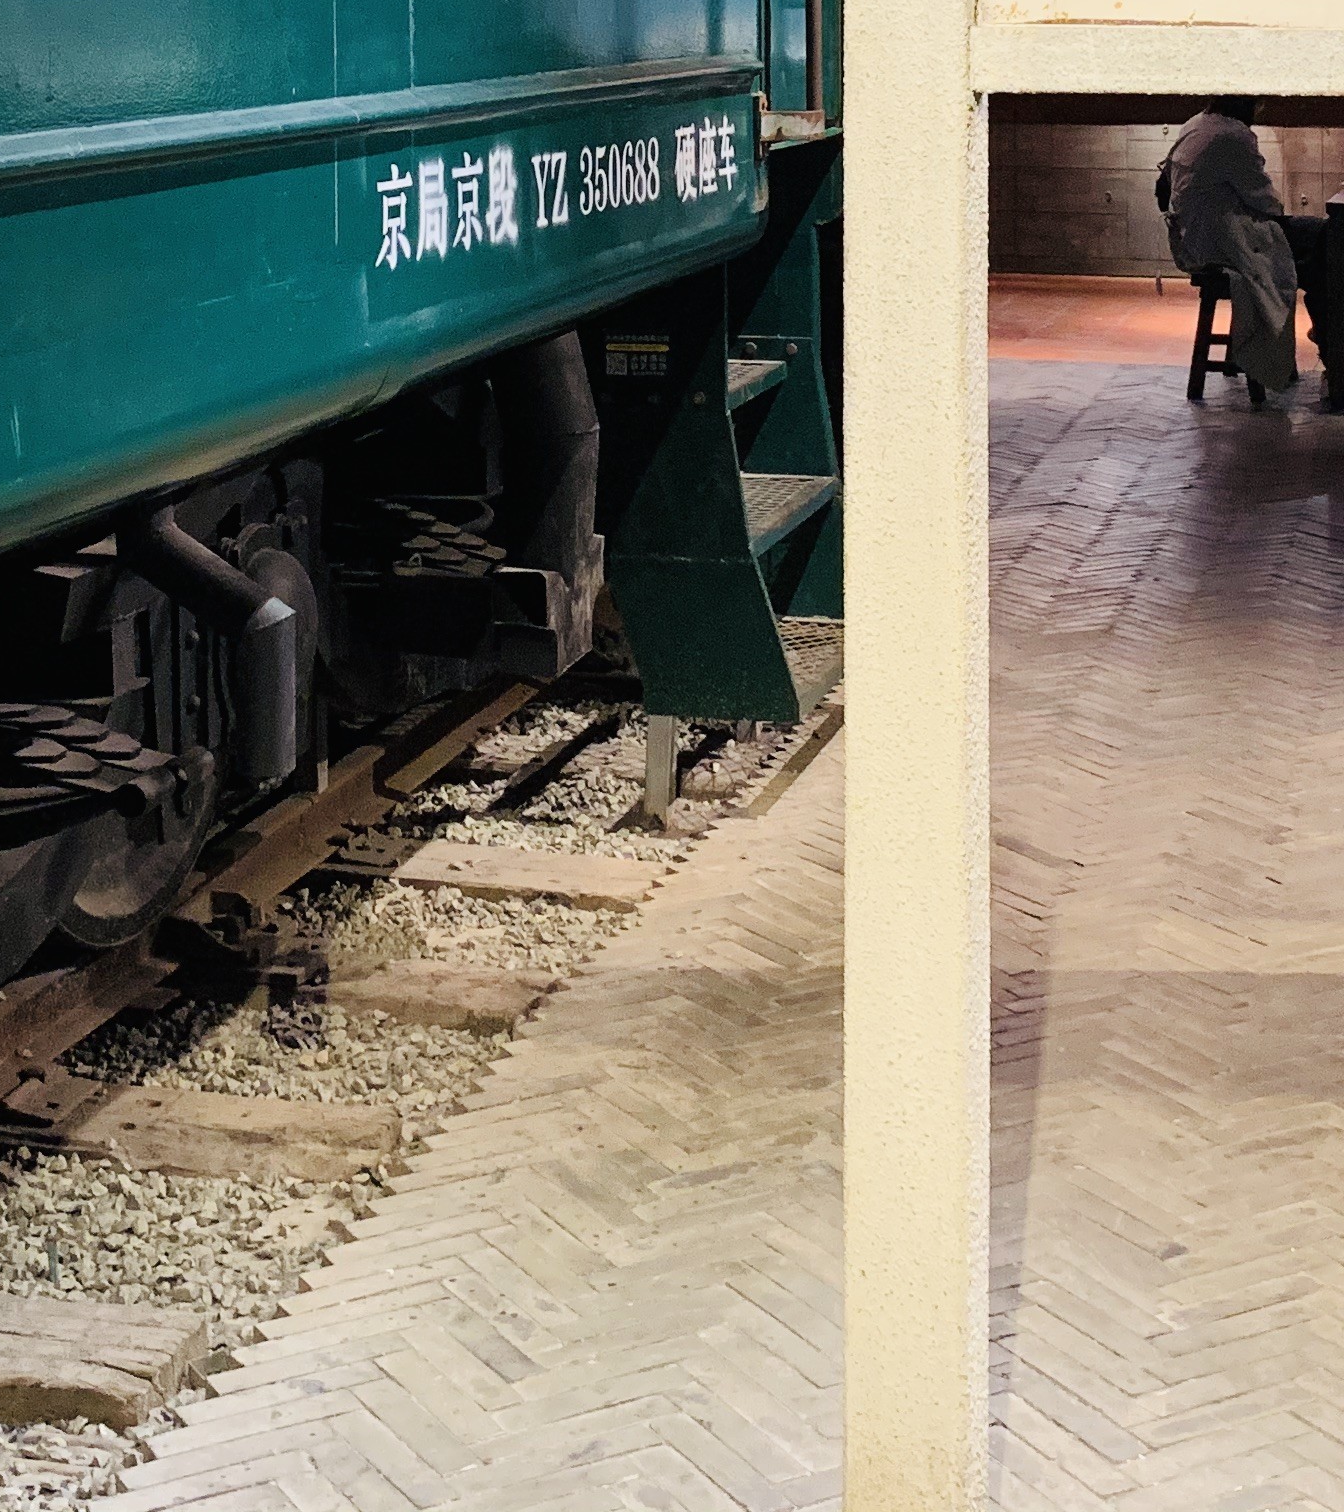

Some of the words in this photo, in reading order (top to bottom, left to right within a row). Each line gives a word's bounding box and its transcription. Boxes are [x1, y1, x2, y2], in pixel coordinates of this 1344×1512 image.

[374, 144, 520, 272] 京局京段
[530, 150, 570, 229] YZ
[578, 136, 661, 217] 350688
[673, 113, 739, 204] 硬座车
